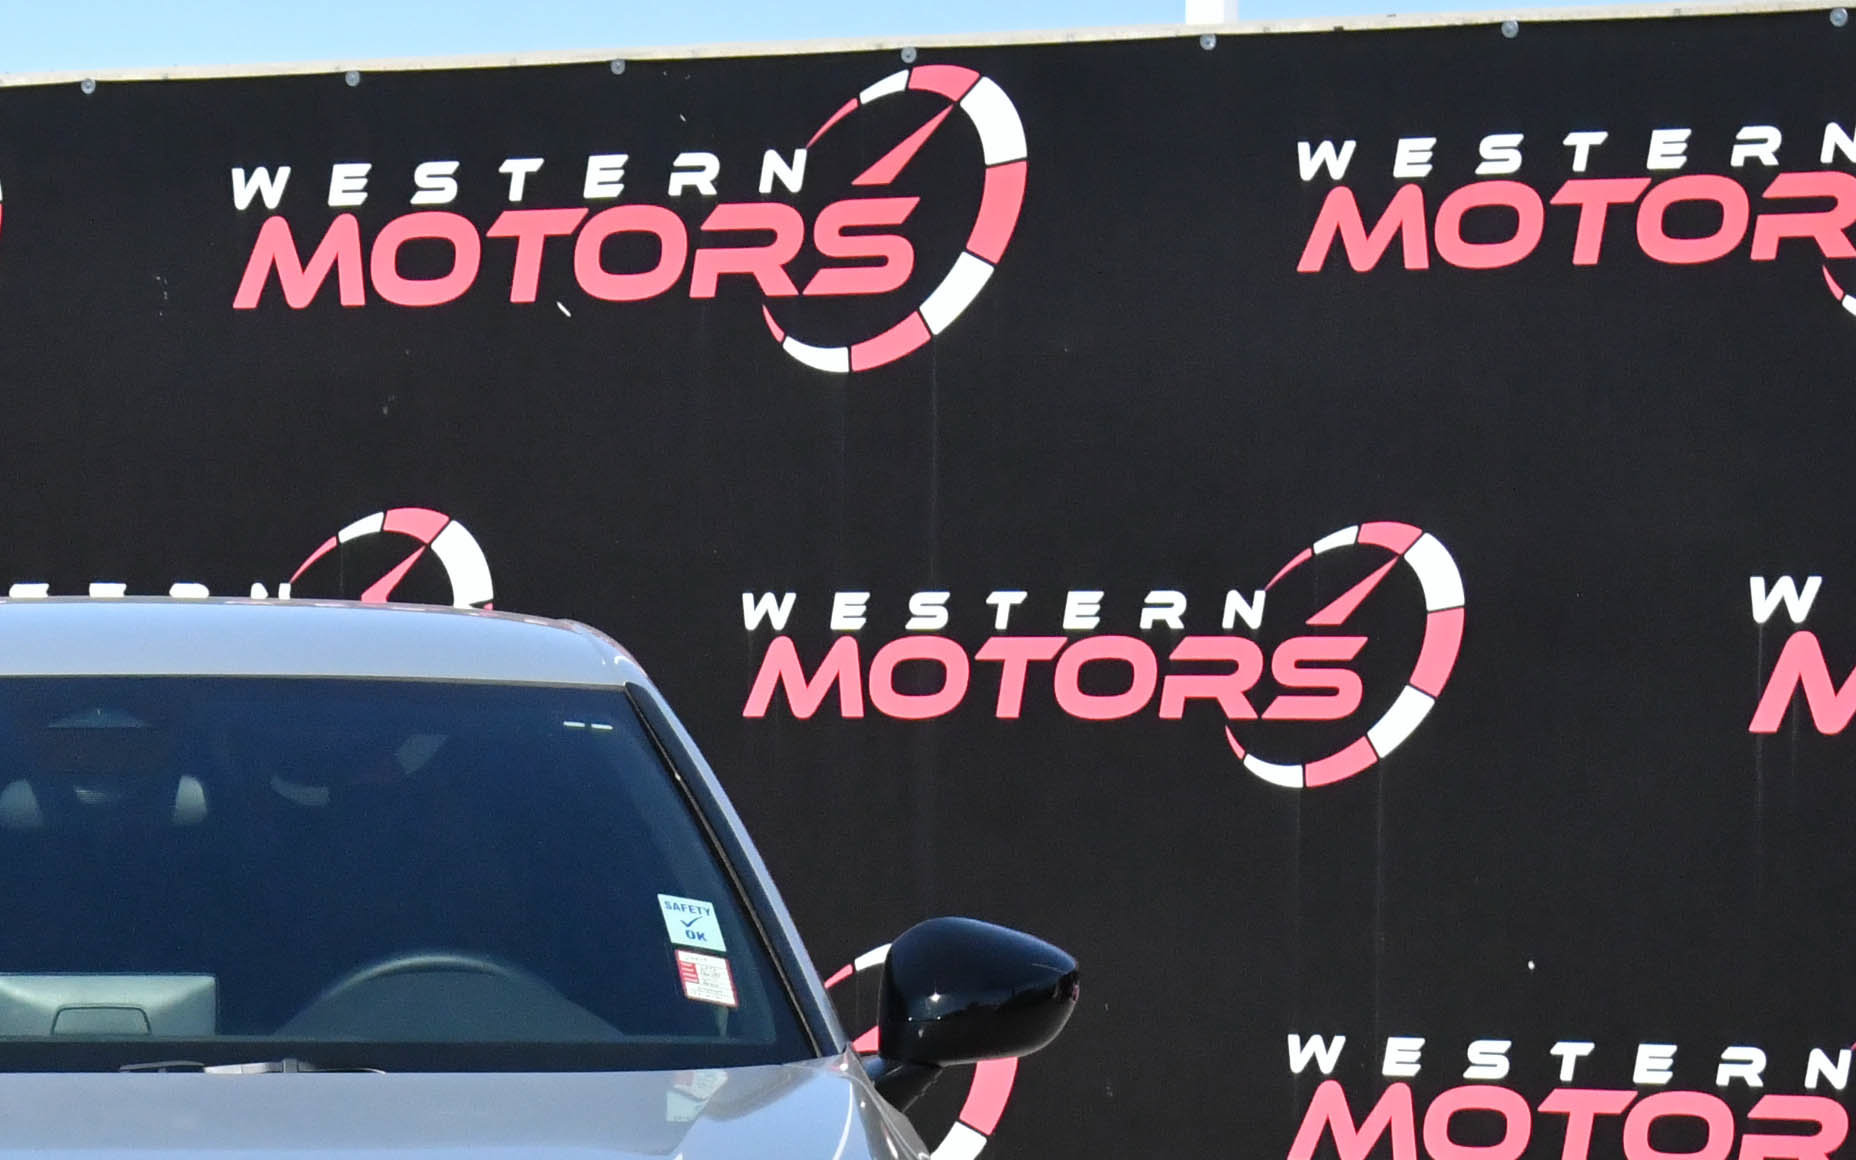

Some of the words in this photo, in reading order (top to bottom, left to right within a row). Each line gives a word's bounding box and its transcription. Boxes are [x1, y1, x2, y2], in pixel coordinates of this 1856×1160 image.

[232, 149, 807, 211] WESTERN
[1298, 122, 1856, 182] WESTERN
[233, 197, 921, 309] MOTORS
[743, 590, 1265, 631] WESTERN
[743, 635, 1368, 720] MOTORS
[664, 901, 710, 917] SAFETY
[685, 930, 707, 942] OK
[1288, 1034, 1852, 1091] WESTERN
